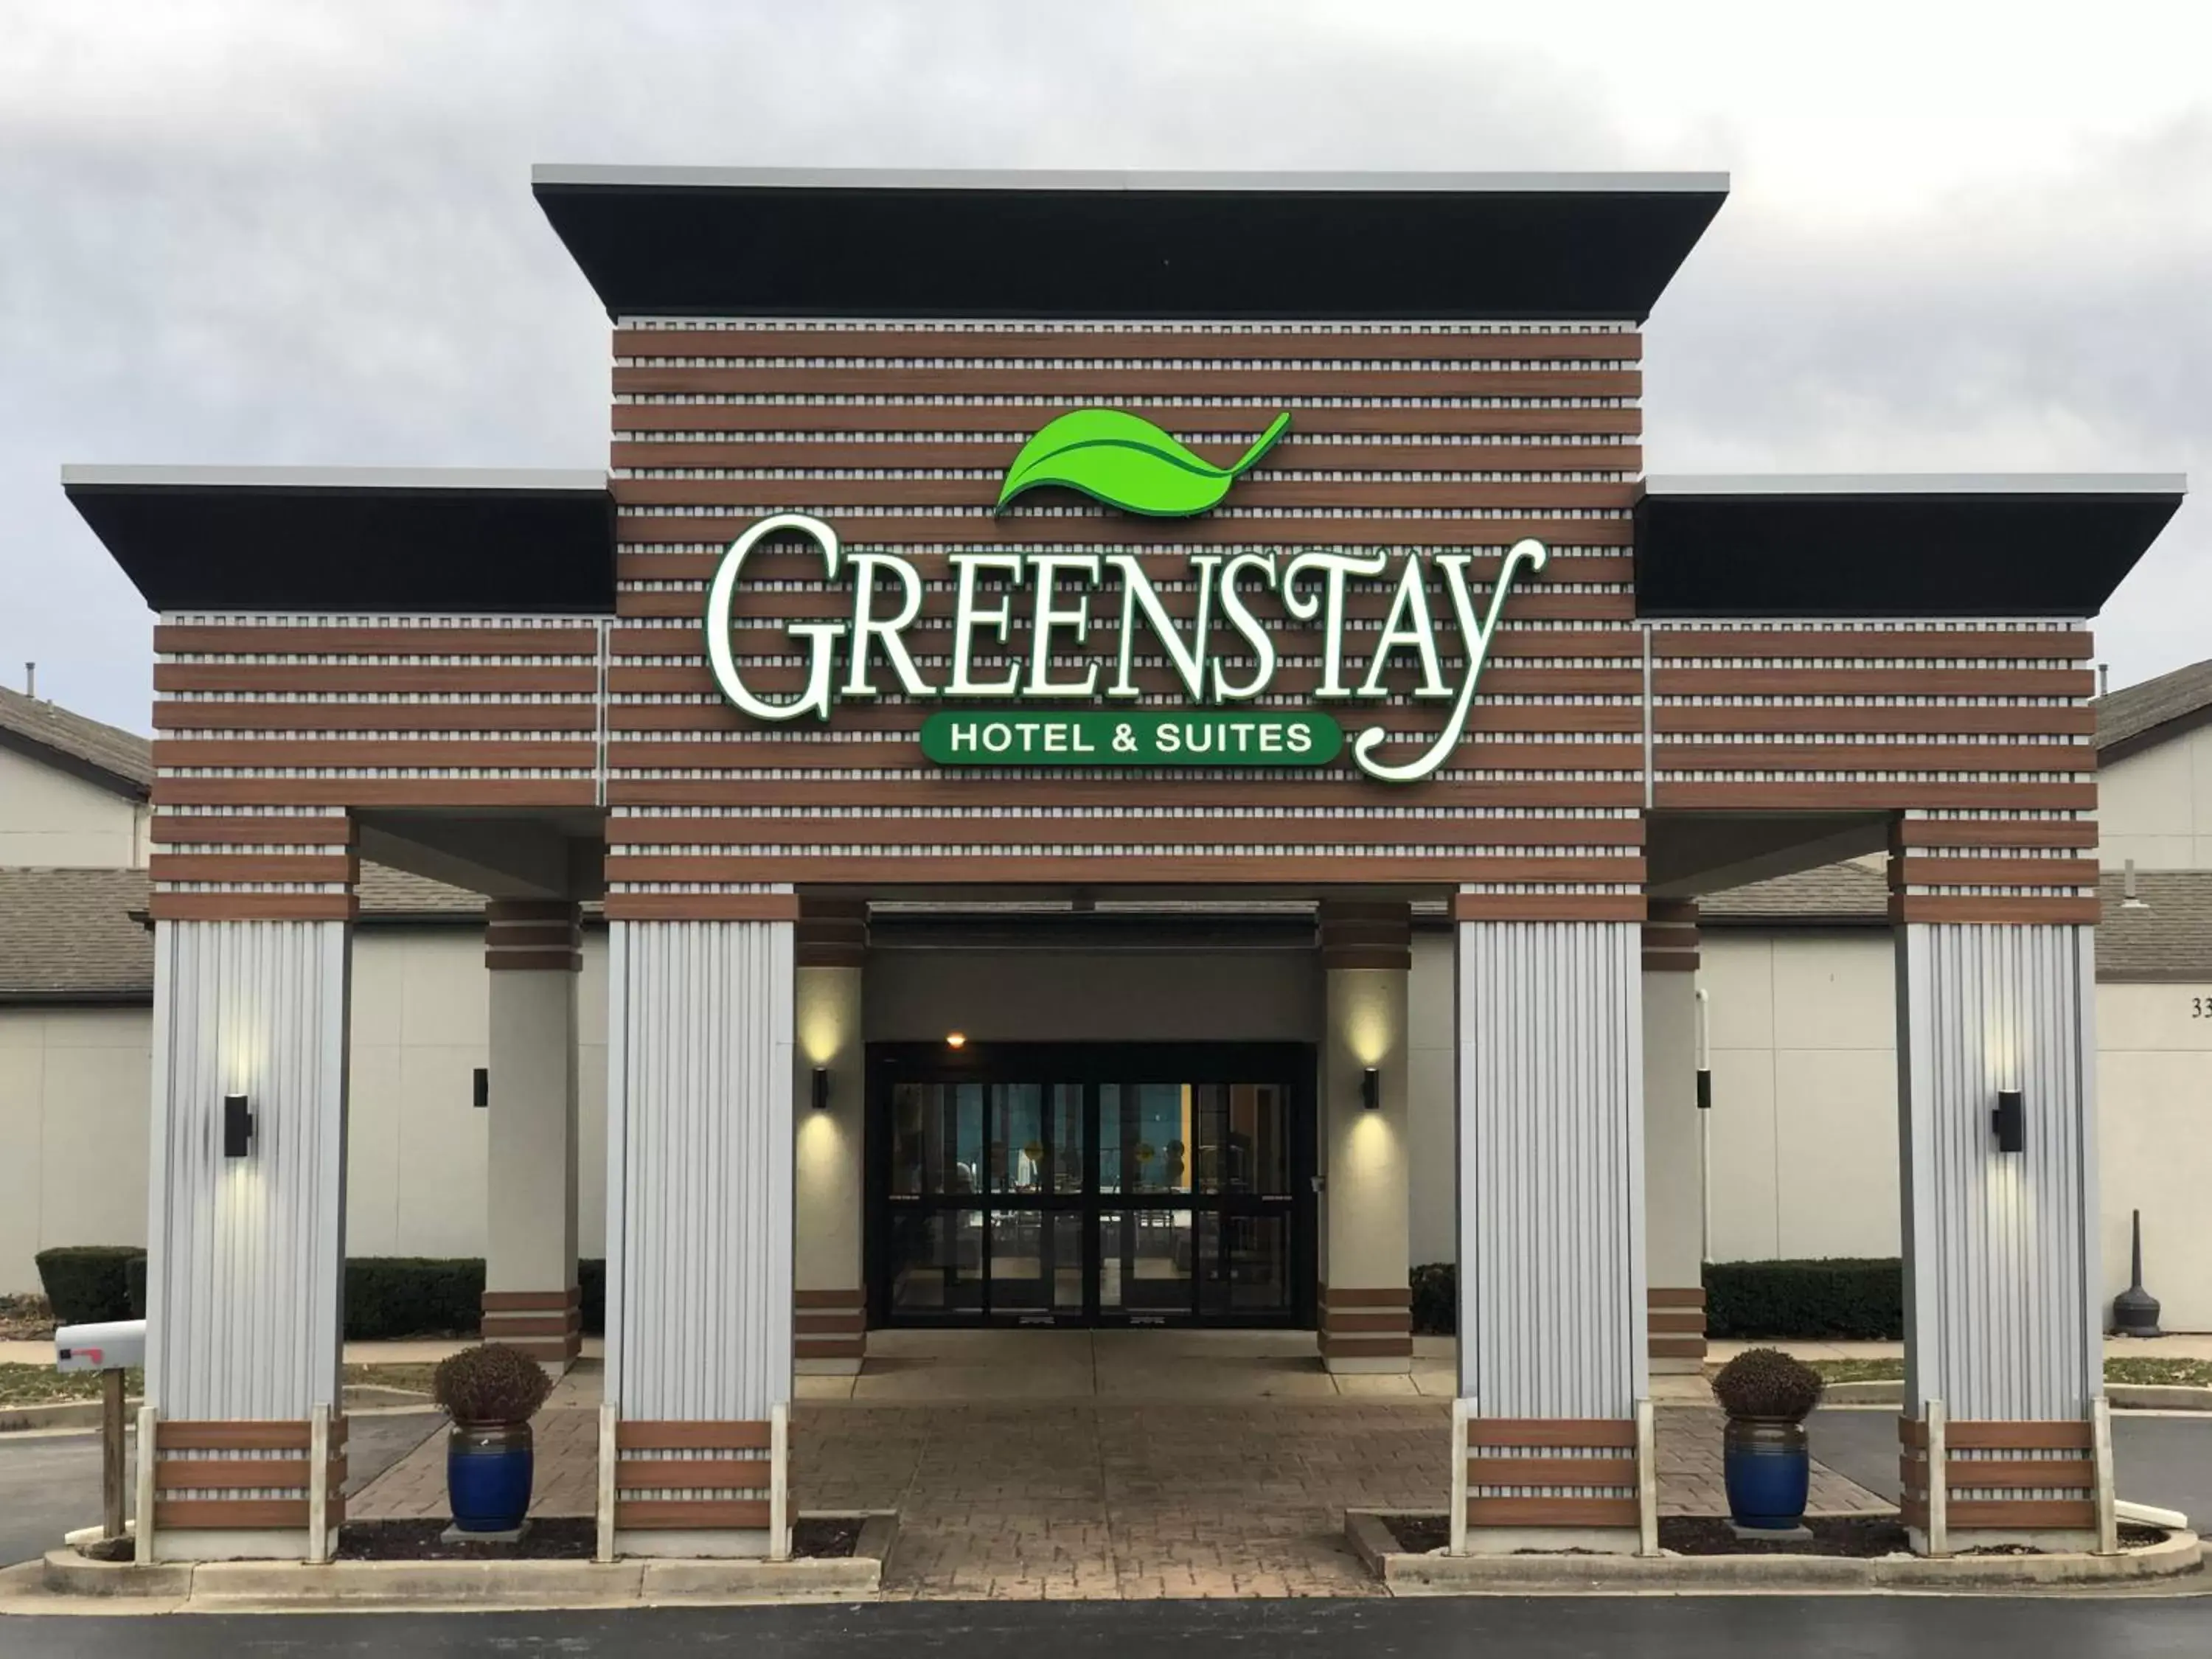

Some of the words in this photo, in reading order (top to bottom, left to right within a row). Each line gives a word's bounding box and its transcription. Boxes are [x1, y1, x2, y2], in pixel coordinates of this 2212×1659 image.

[950, 723, 1095, 752] HOTEL
[1111, 723, 1138, 752] &
[1153, 723, 1312, 752] SUITES
